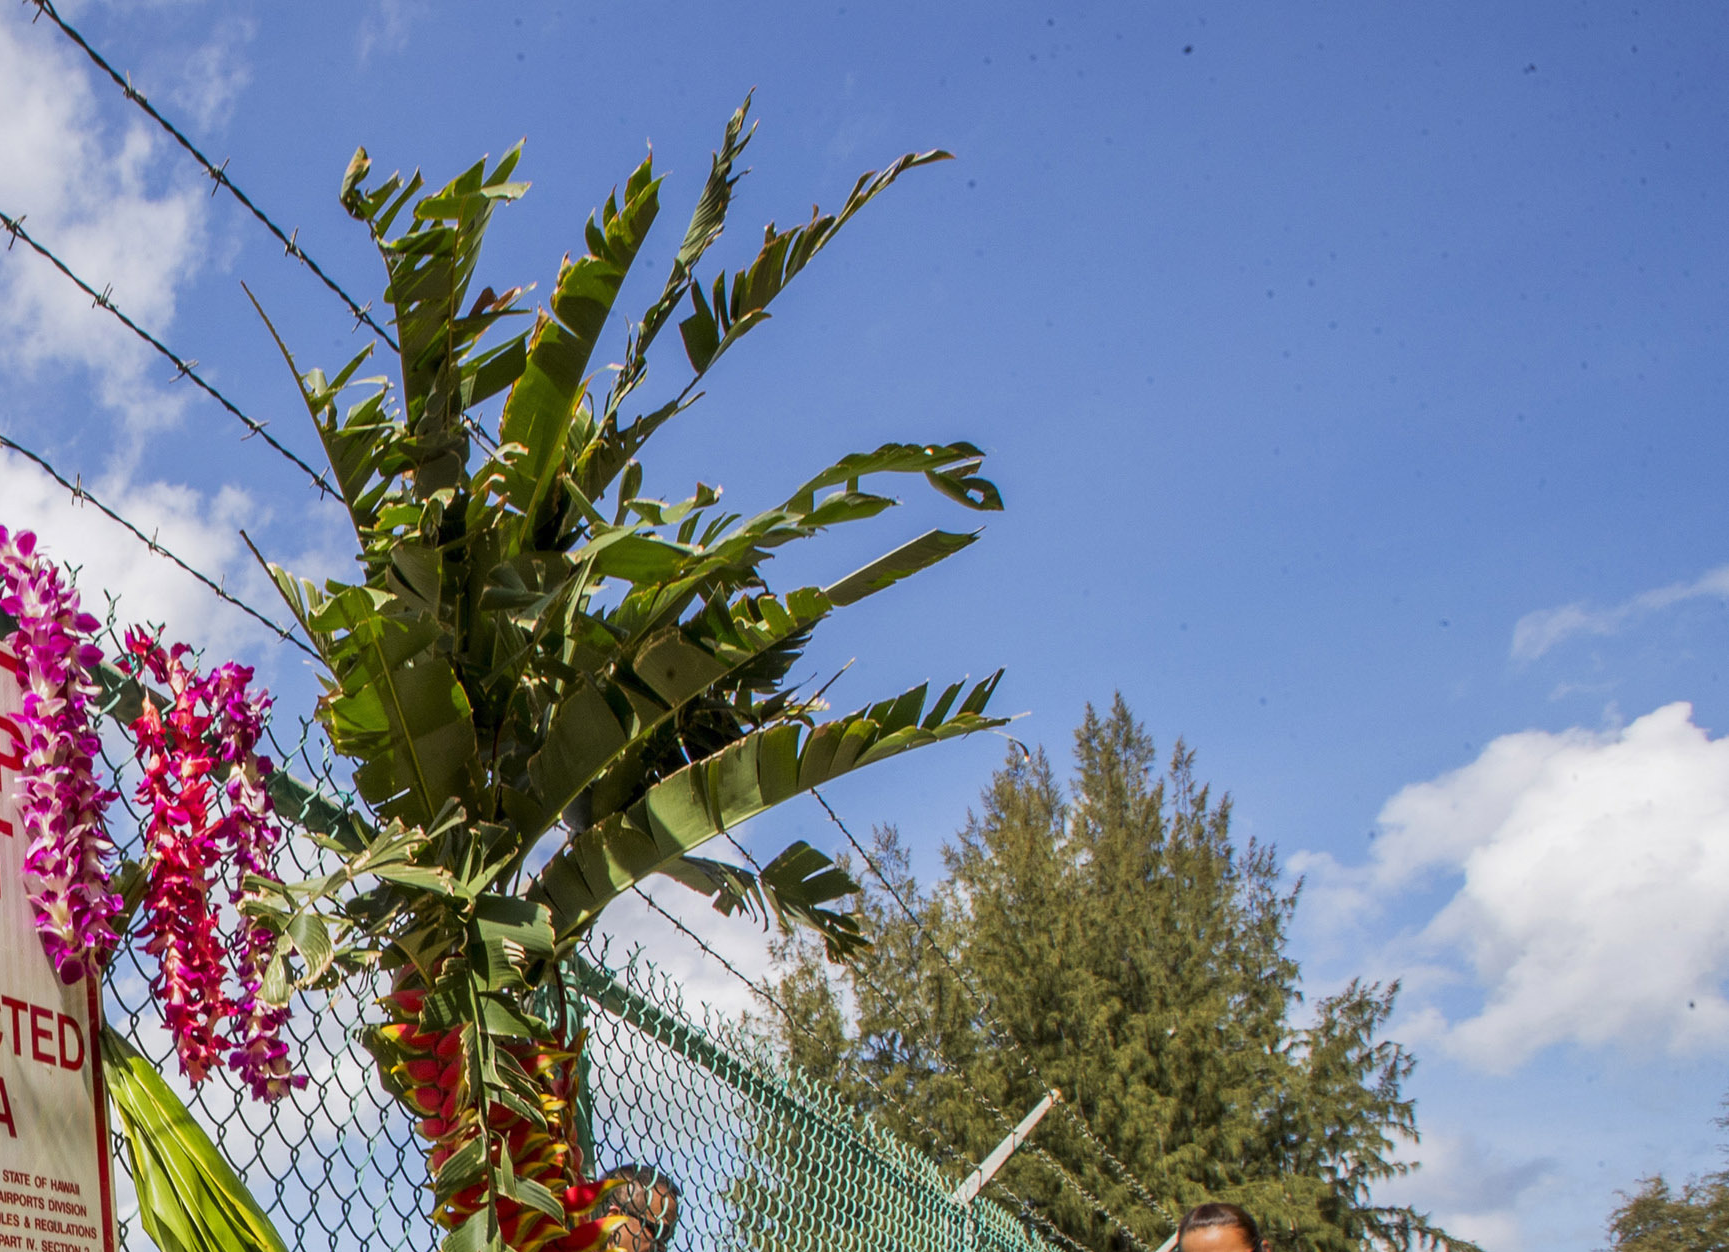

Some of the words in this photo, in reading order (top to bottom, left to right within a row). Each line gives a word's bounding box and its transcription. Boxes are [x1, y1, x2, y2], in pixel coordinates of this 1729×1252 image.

[2, 1169, 31, 1187] STATE
[34, 1175, 47, 1189] OF
[50, 1179, 81, 1196] HAWAII
[48, 1199, 87, 1217] DIVISION
[24, 1216, 31, 1229] &
[34, 1218, 97, 1240] REGULATIONS
